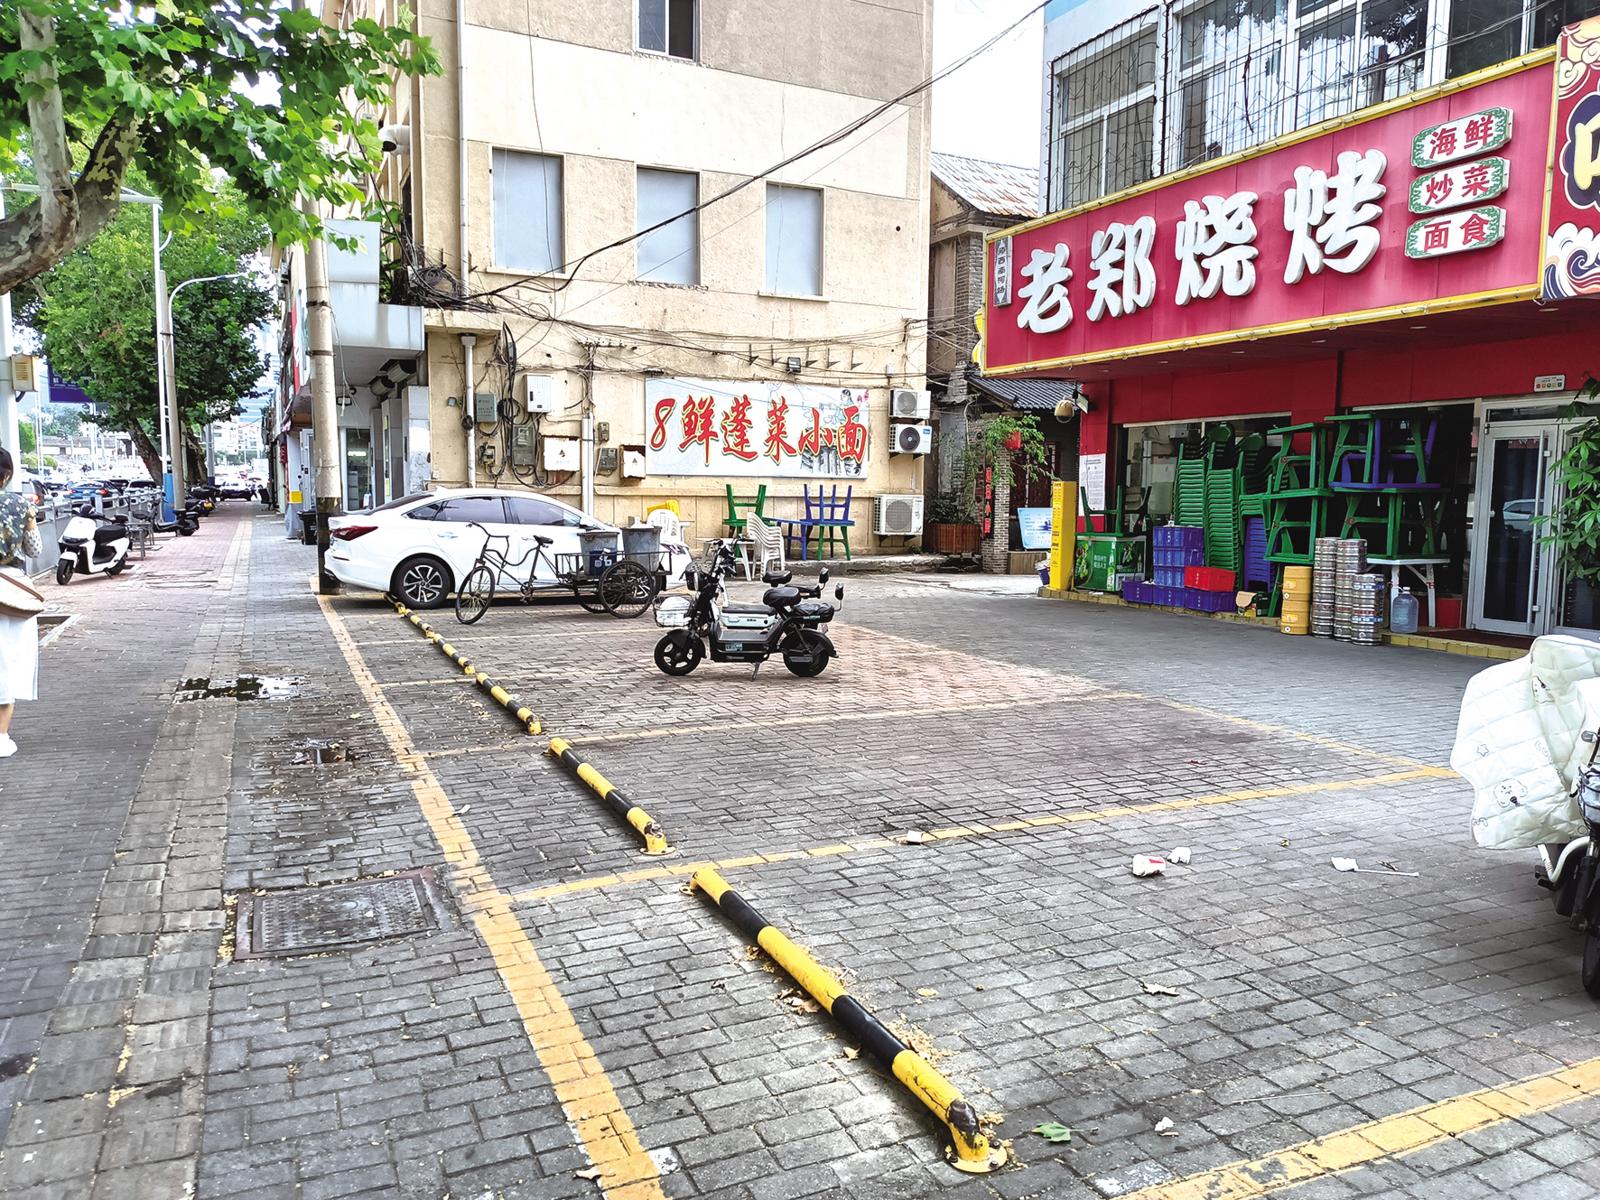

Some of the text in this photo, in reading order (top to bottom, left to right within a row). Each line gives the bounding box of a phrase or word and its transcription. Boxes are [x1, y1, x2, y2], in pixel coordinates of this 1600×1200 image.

[1429, 114, 1494, 159] 海鲜
[1424, 165, 1490, 205] 炒菜
[1017, 149, 1388, 334] 老郑烧烤
[1423, 213, 1489, 252] 面食
[650, 393, 868, 465] 8鲜蓬莱小面
